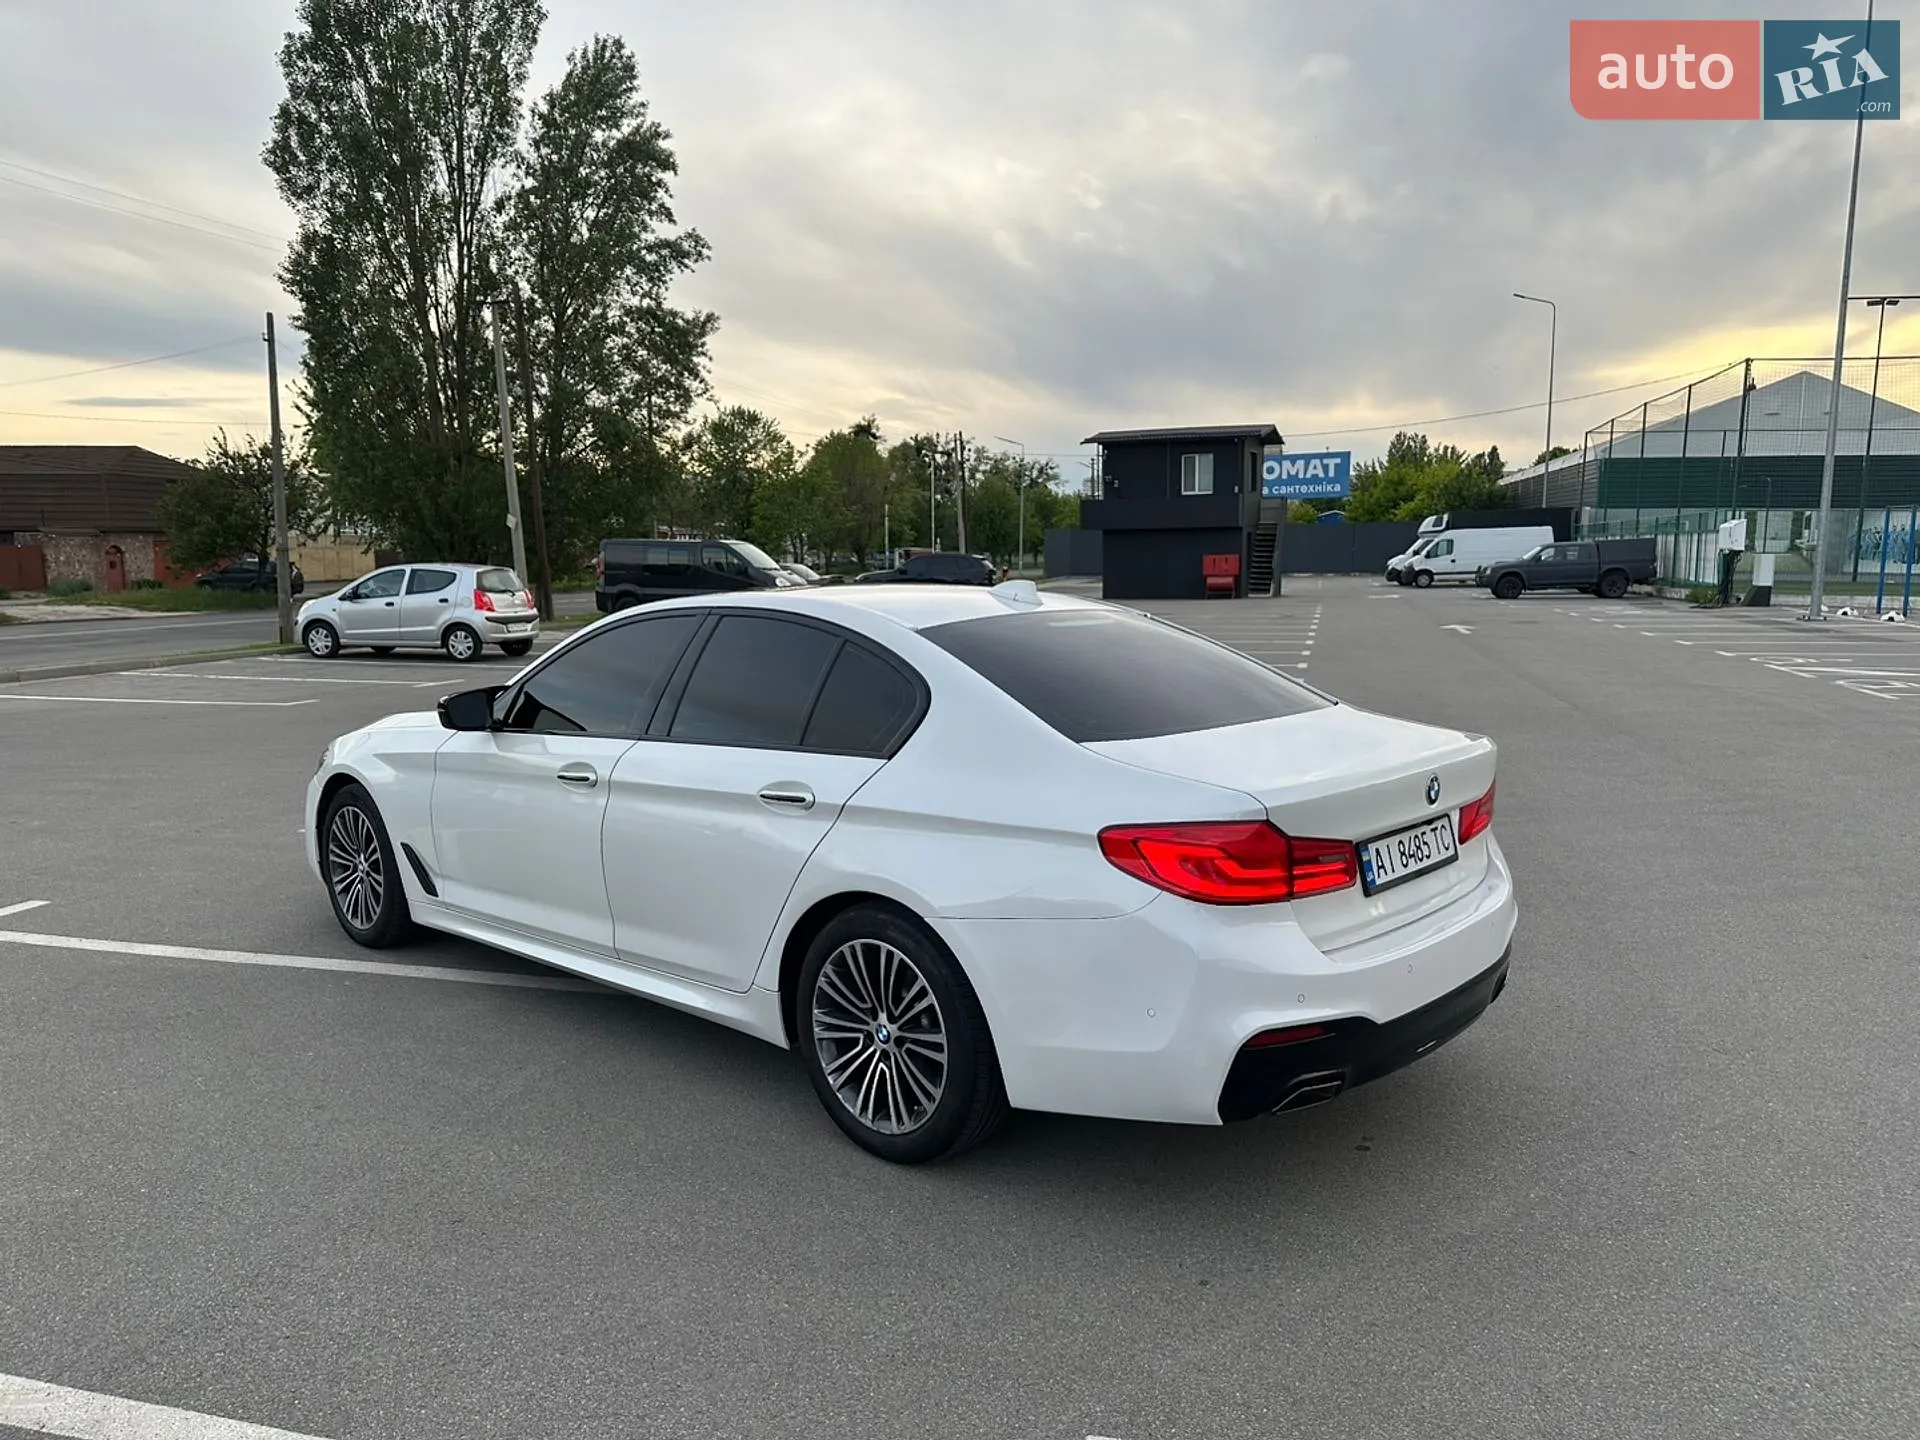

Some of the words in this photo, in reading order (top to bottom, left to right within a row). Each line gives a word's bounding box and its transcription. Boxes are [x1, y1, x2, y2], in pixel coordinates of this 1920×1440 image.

[1272, 481, 1341, 494] сантехніка
[1375, 845, 1395, 878] AI
[1398, 832, 1431, 868] 8485
[1431, 824, 1450, 855] TC
